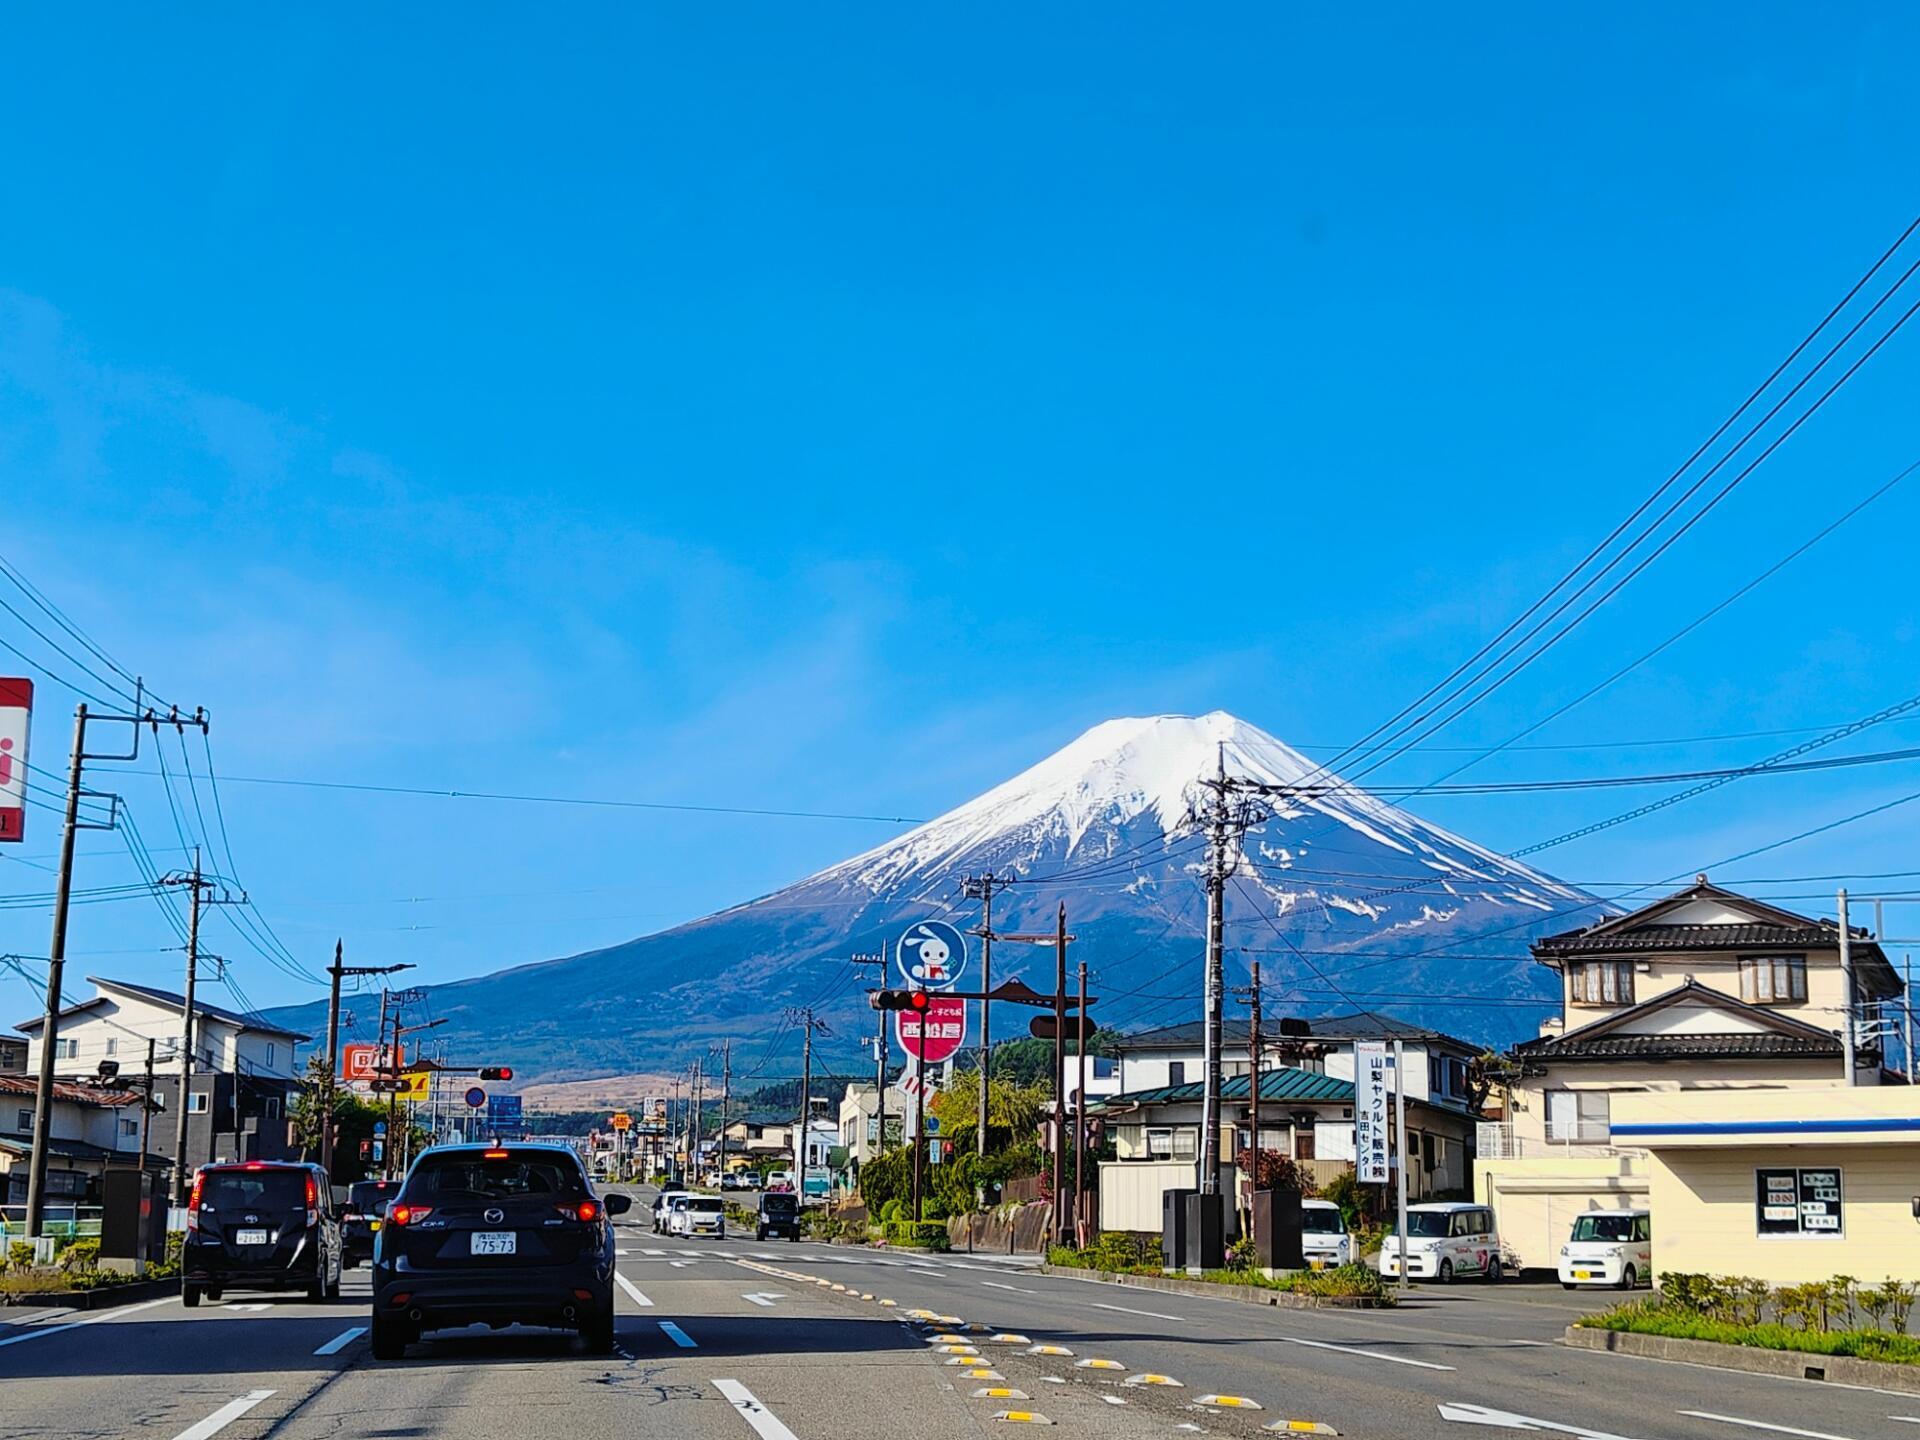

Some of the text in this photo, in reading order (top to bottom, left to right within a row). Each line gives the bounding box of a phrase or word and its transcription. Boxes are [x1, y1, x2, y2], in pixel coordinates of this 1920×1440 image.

[1360, 1110, 1370, 1177] 吉田センター
